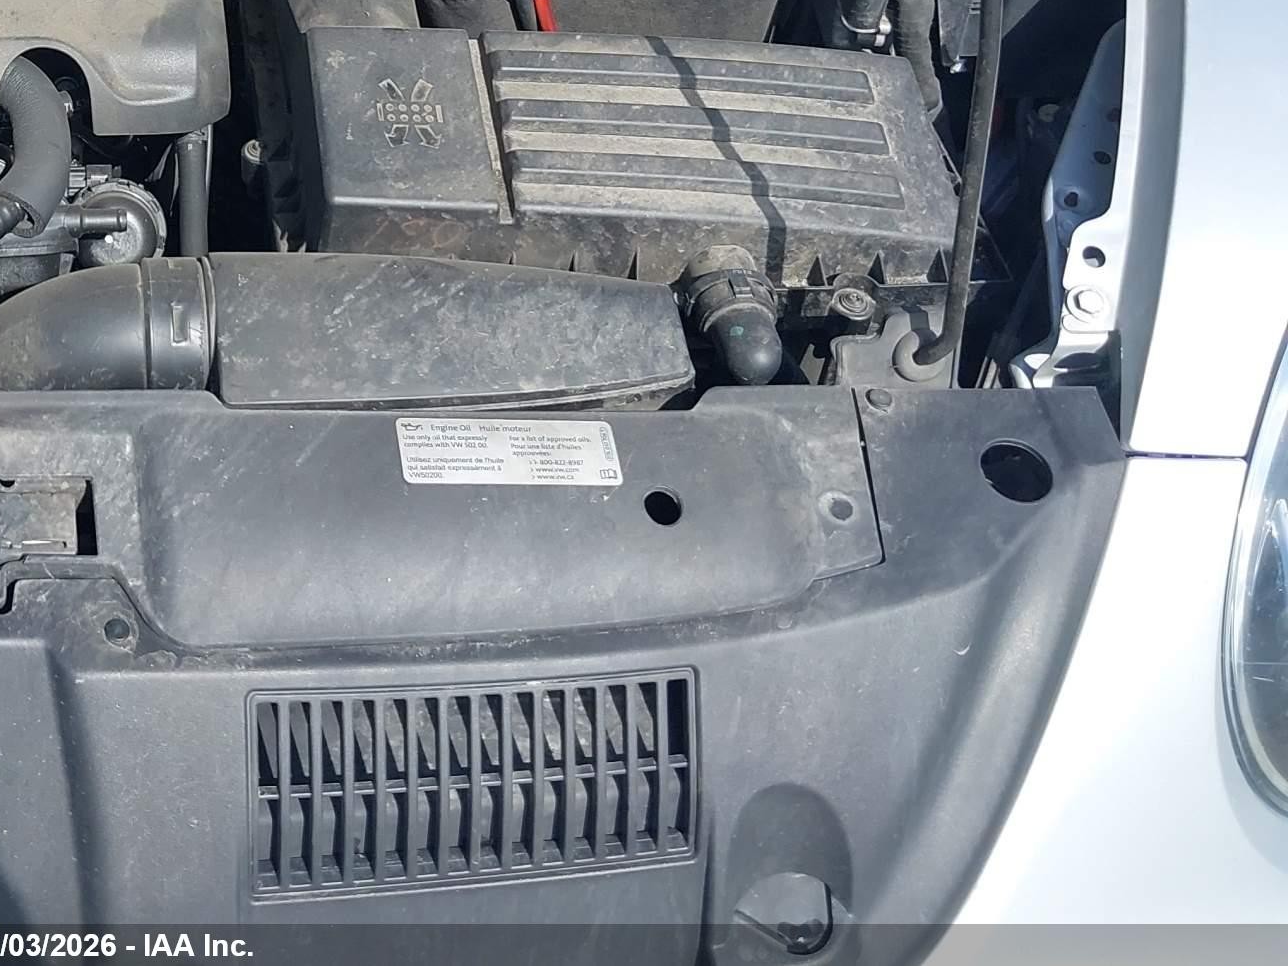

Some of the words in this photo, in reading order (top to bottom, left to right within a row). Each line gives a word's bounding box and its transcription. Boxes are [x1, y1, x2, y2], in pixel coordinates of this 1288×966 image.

[430, 424, 458, 433] Engine
[459, 424, 471, 432] Oil
[416, 434, 430, 442] only
